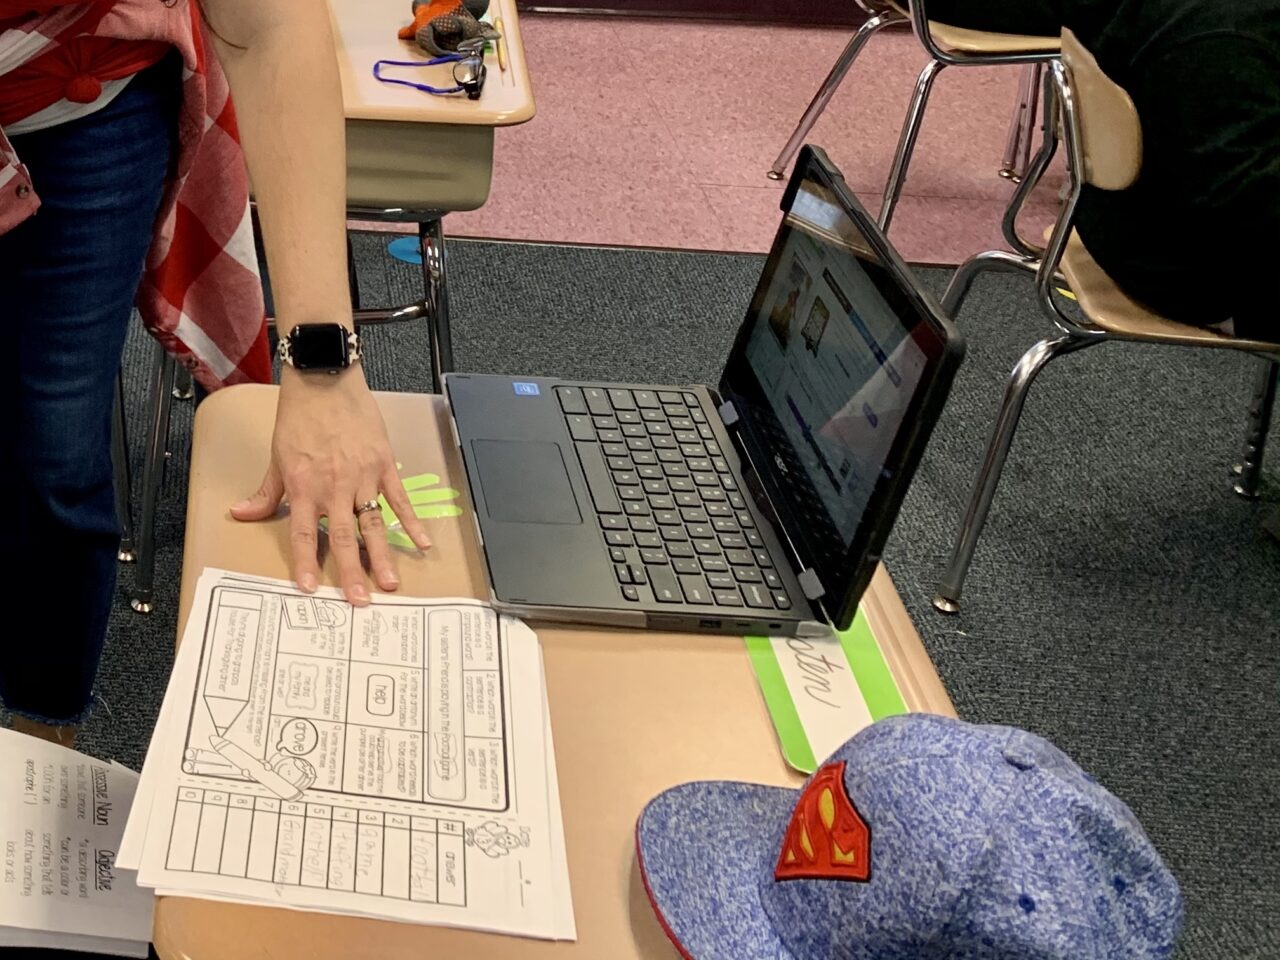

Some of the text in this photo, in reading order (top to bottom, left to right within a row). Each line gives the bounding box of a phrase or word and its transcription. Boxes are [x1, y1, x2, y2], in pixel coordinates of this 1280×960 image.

[786, 635, 845, 709] sten
[372, 684, 389, 704] help
[293, 722, 308, 752] drove
[97, 802, 112, 825] Noun
[443, 823, 456, 832] #
